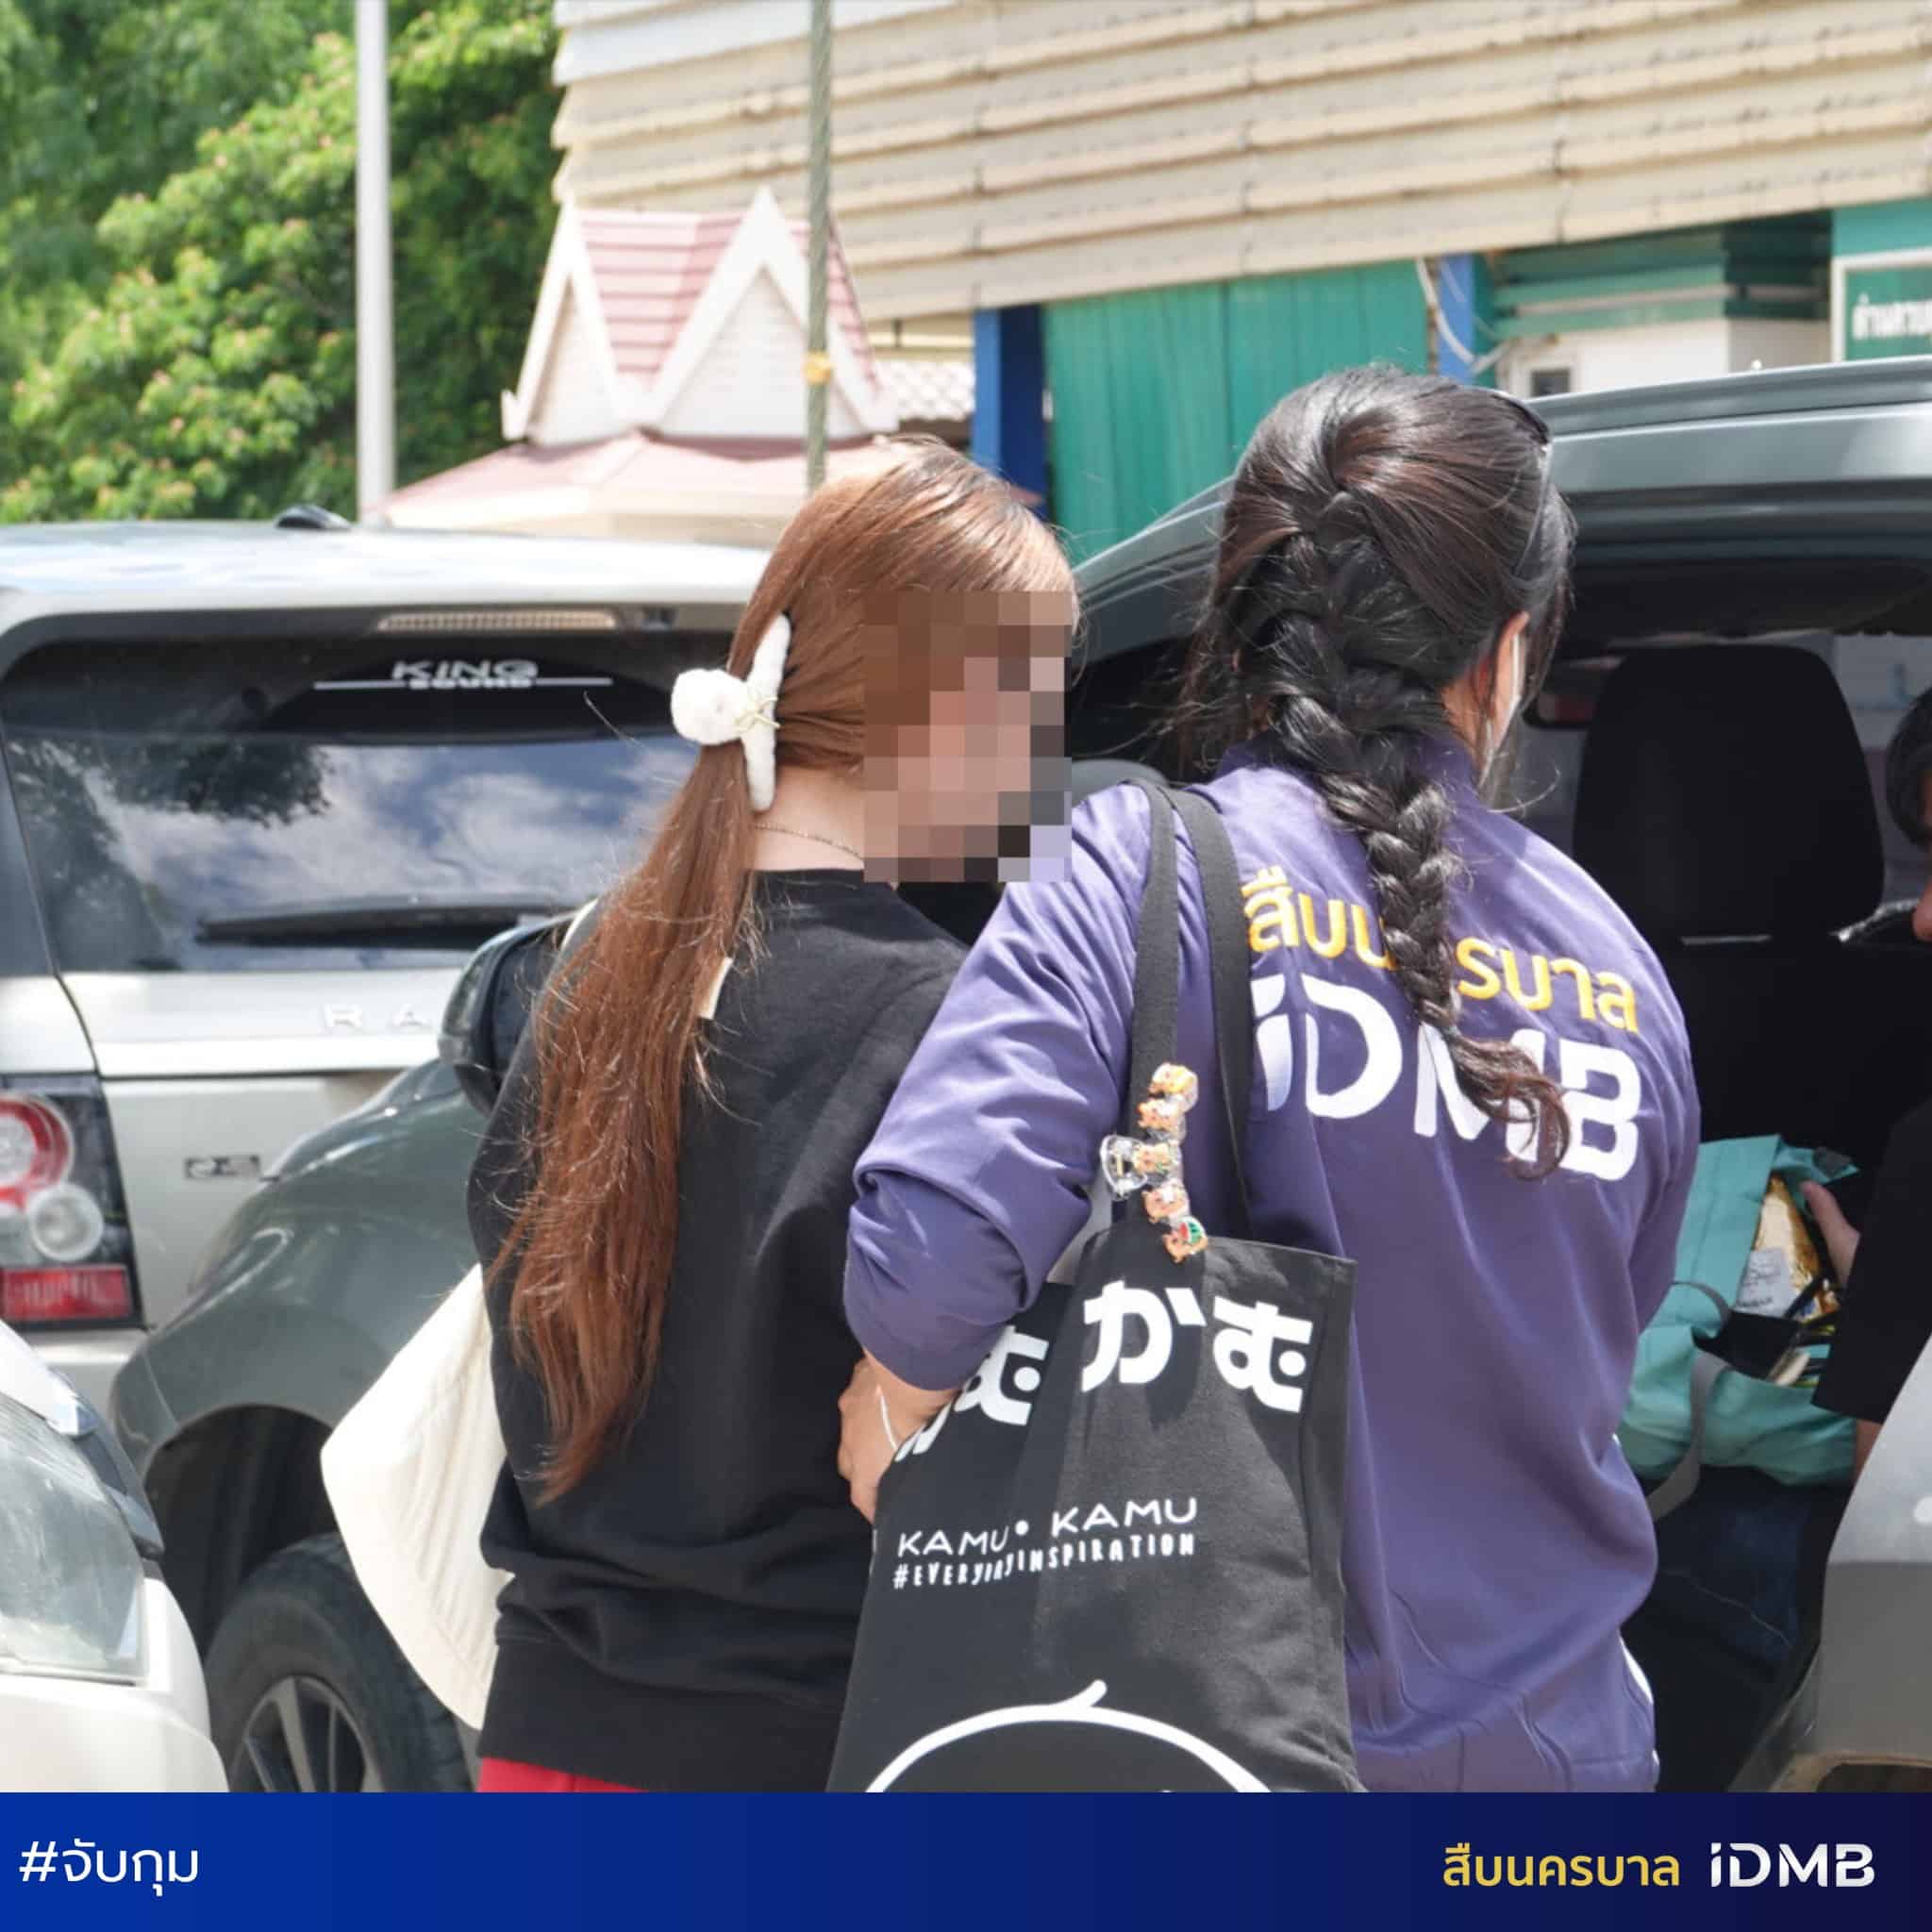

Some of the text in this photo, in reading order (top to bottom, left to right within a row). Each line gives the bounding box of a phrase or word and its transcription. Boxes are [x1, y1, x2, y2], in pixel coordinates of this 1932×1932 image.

[391, 659, 538, 680] KING
[898, 1497, 1197, 1557] KAMU KAMU
